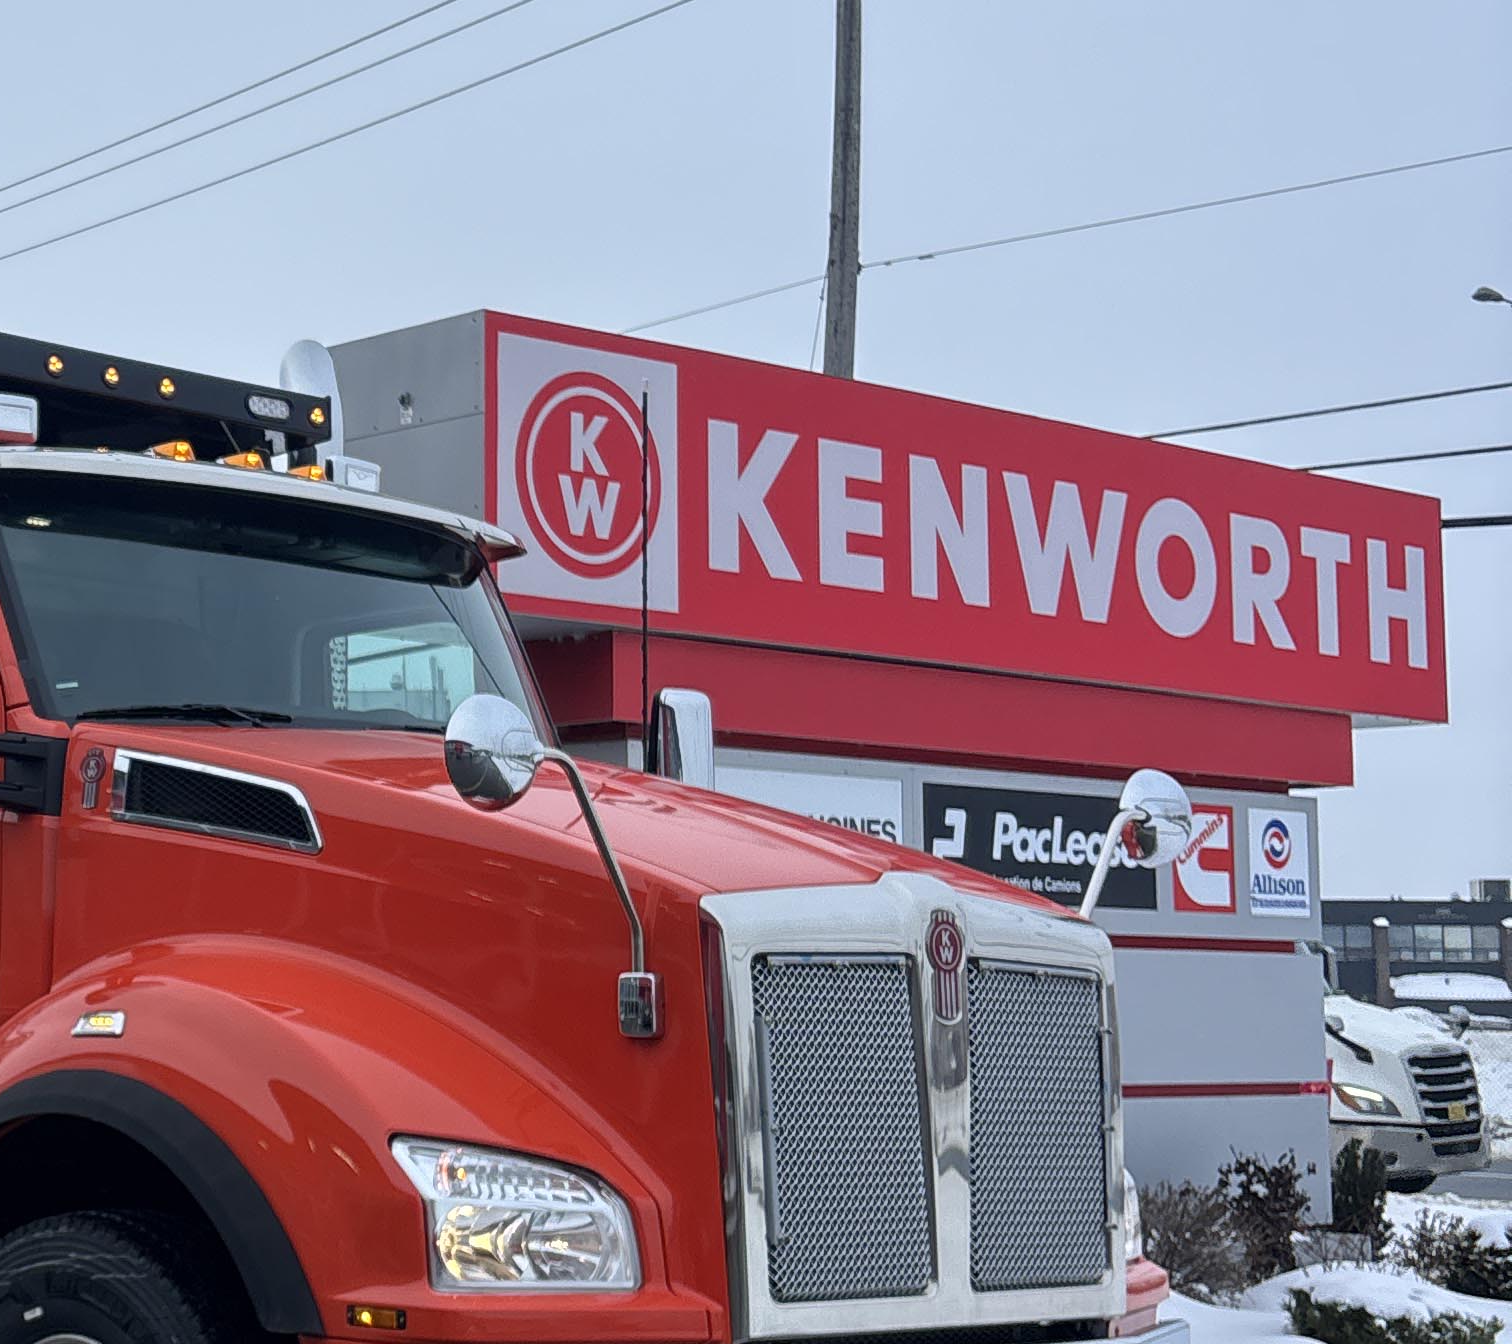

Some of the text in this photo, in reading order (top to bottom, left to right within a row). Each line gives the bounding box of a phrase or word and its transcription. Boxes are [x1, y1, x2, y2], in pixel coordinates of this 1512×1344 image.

[707, 418, 1429, 669] KENWORTH
[1044, 876, 1082, 893] Camions
[1252, 874, 1306, 895] Allison
